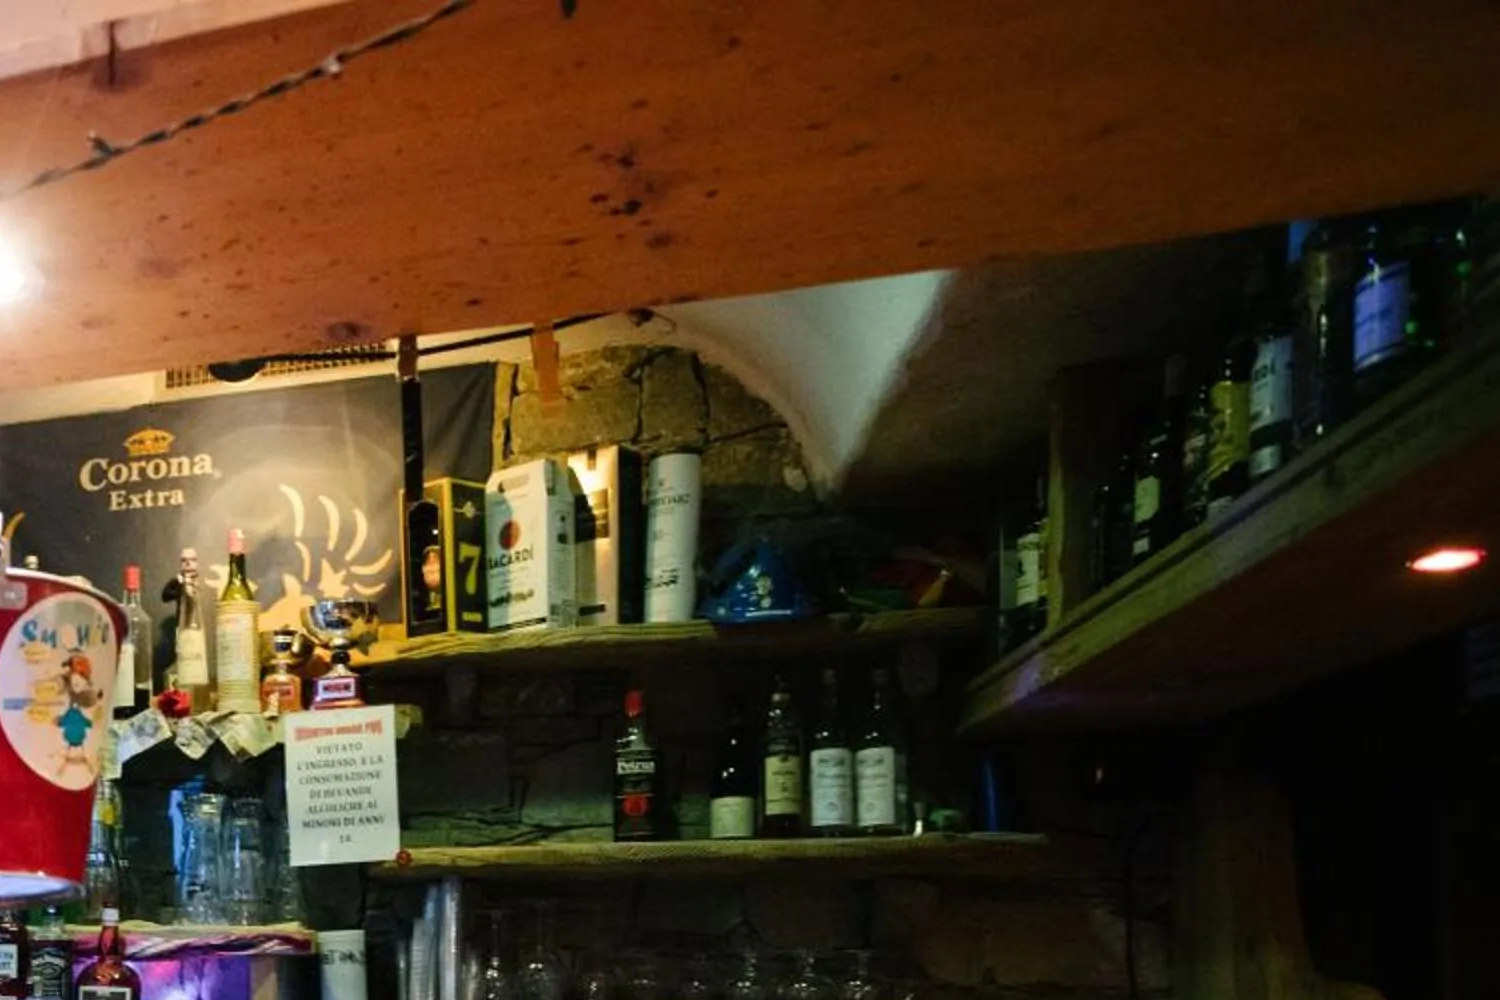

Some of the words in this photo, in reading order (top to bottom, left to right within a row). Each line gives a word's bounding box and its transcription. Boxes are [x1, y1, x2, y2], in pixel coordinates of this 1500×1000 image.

[79, 453, 214, 492] Corona
[108, 488, 185, 512] Extra
[458, 543, 481, 595] 7
[316, 742, 363, 755] VIETATO
